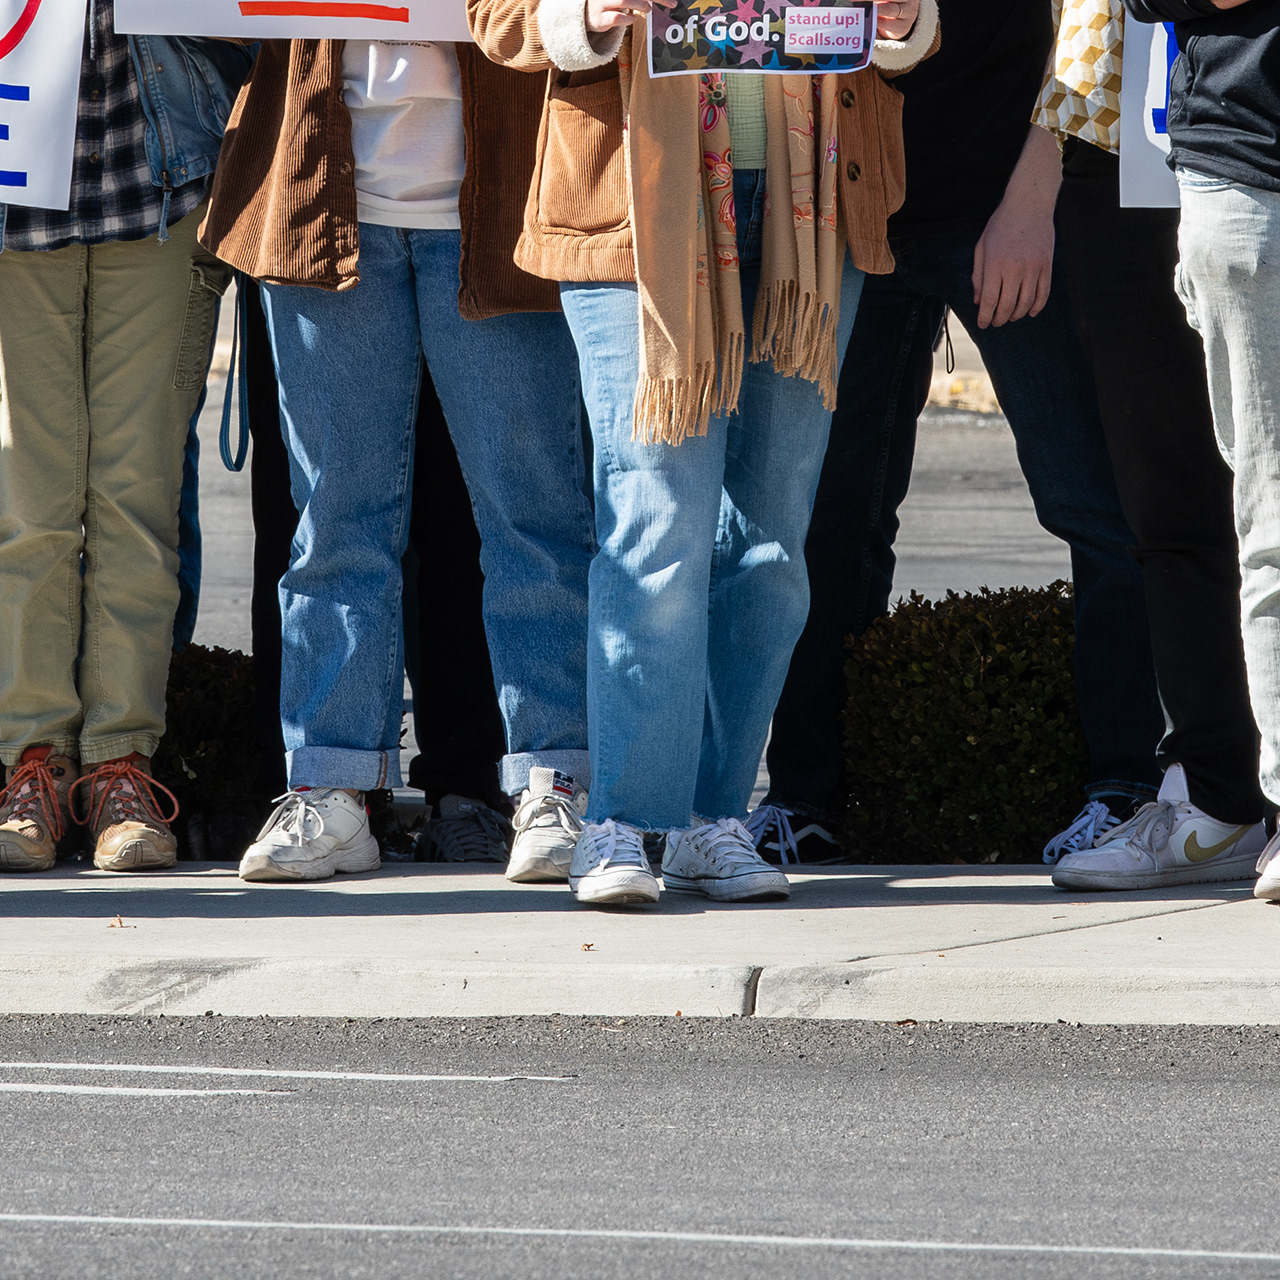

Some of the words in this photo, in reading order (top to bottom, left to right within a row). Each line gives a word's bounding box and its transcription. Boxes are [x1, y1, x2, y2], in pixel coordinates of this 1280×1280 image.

[665, 15, 699, 44] of
[705, 13, 780, 43] God.
[788, 12, 830, 26] stand
[835, 12, 860, 29] up!
[788, 33, 862, 49] 5calls.org
[555, 780, 572, 790] FILA
